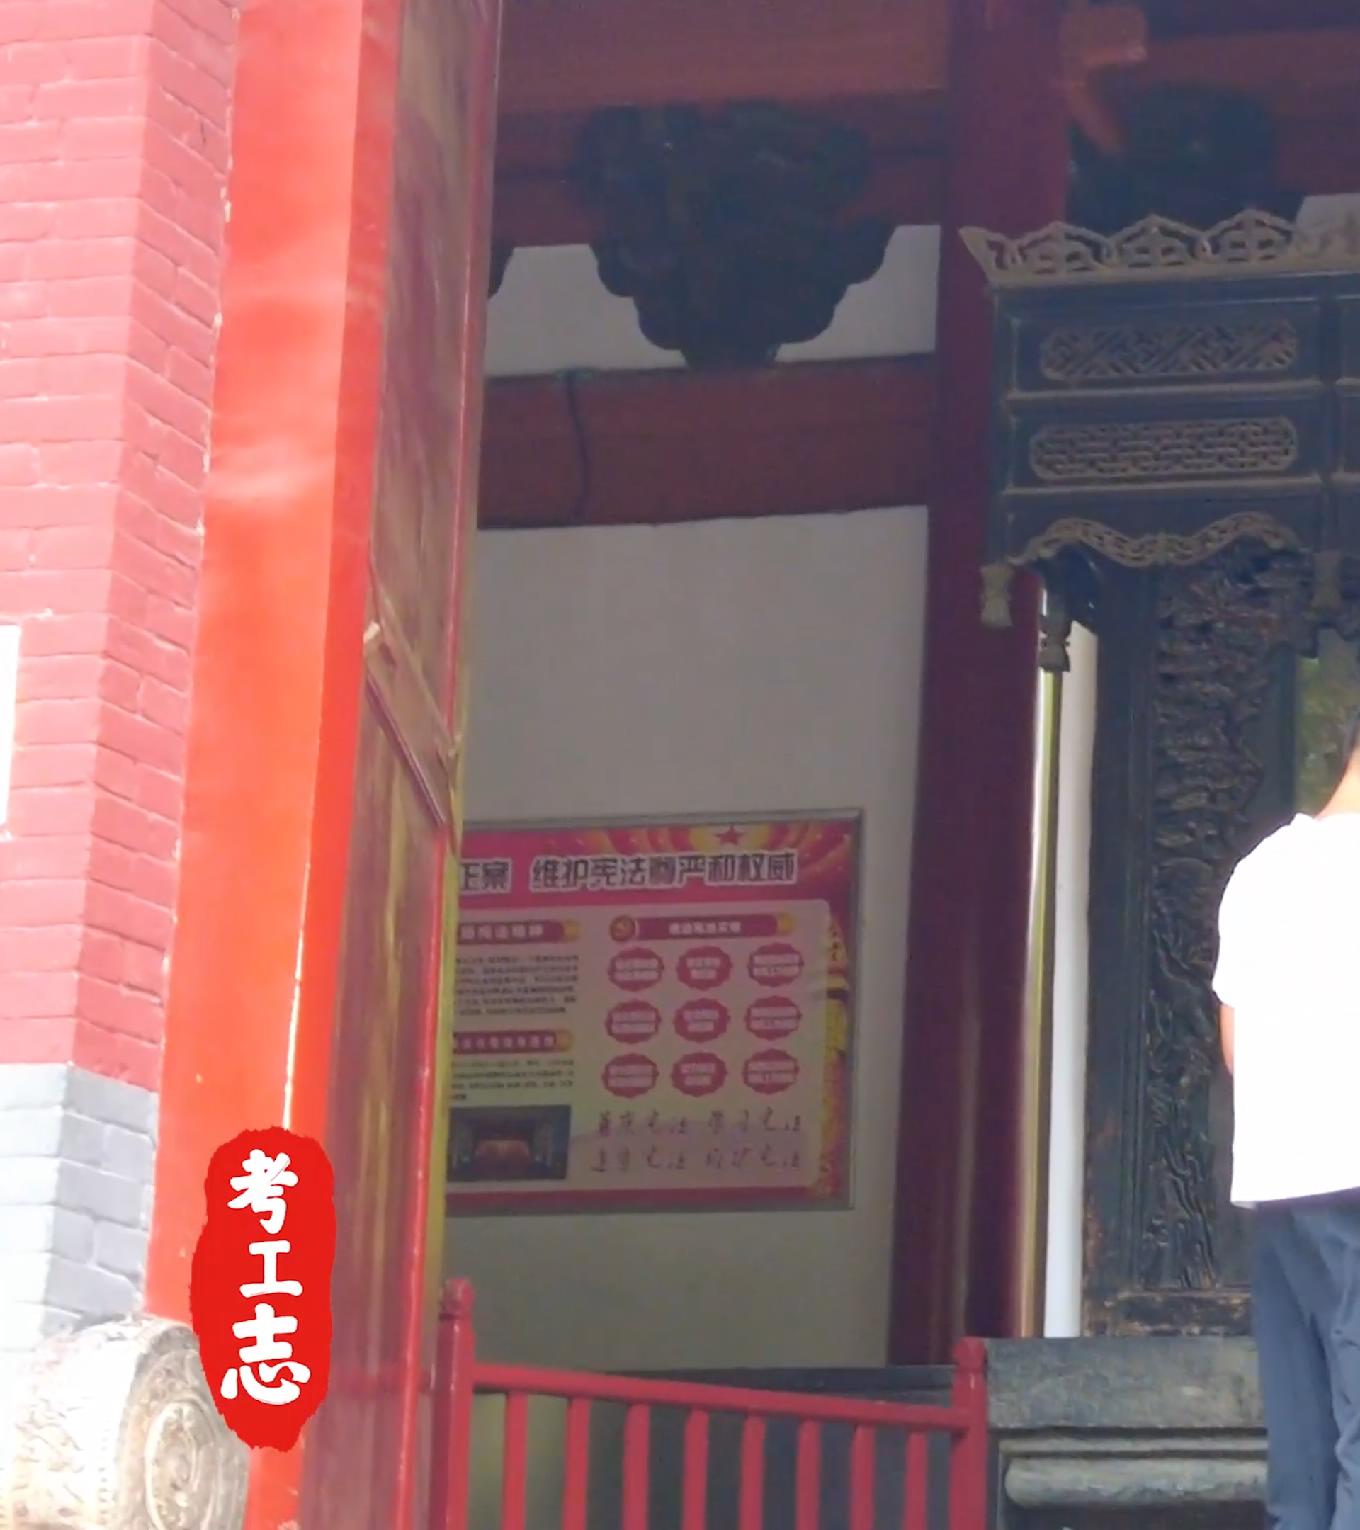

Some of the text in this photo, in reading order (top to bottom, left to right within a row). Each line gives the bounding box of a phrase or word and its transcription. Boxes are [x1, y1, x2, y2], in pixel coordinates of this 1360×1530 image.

[531, 852, 796, 891] 维护宪法尊严和权威
